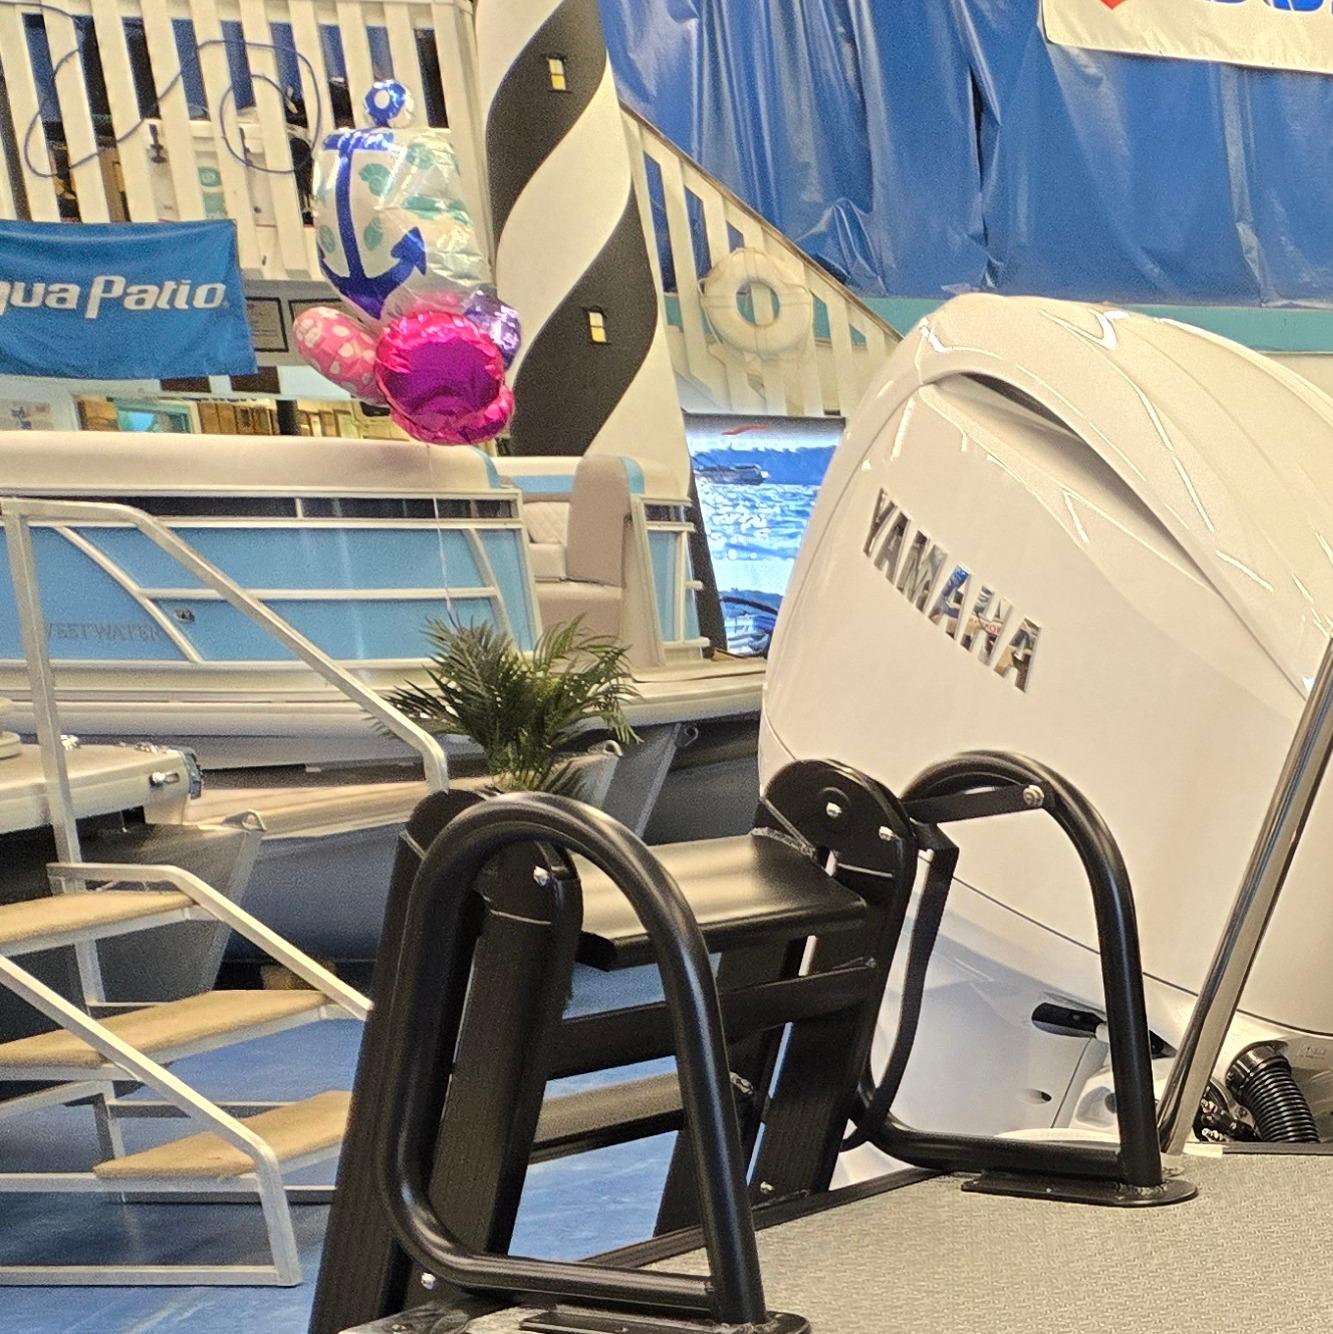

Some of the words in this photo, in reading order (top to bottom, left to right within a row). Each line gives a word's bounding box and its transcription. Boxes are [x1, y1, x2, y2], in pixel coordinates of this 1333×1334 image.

[85, 275, 226, 319] Patio
[863, 487, 1042, 693] YAMAHA
[47, 623, 162, 641] EETWATER
